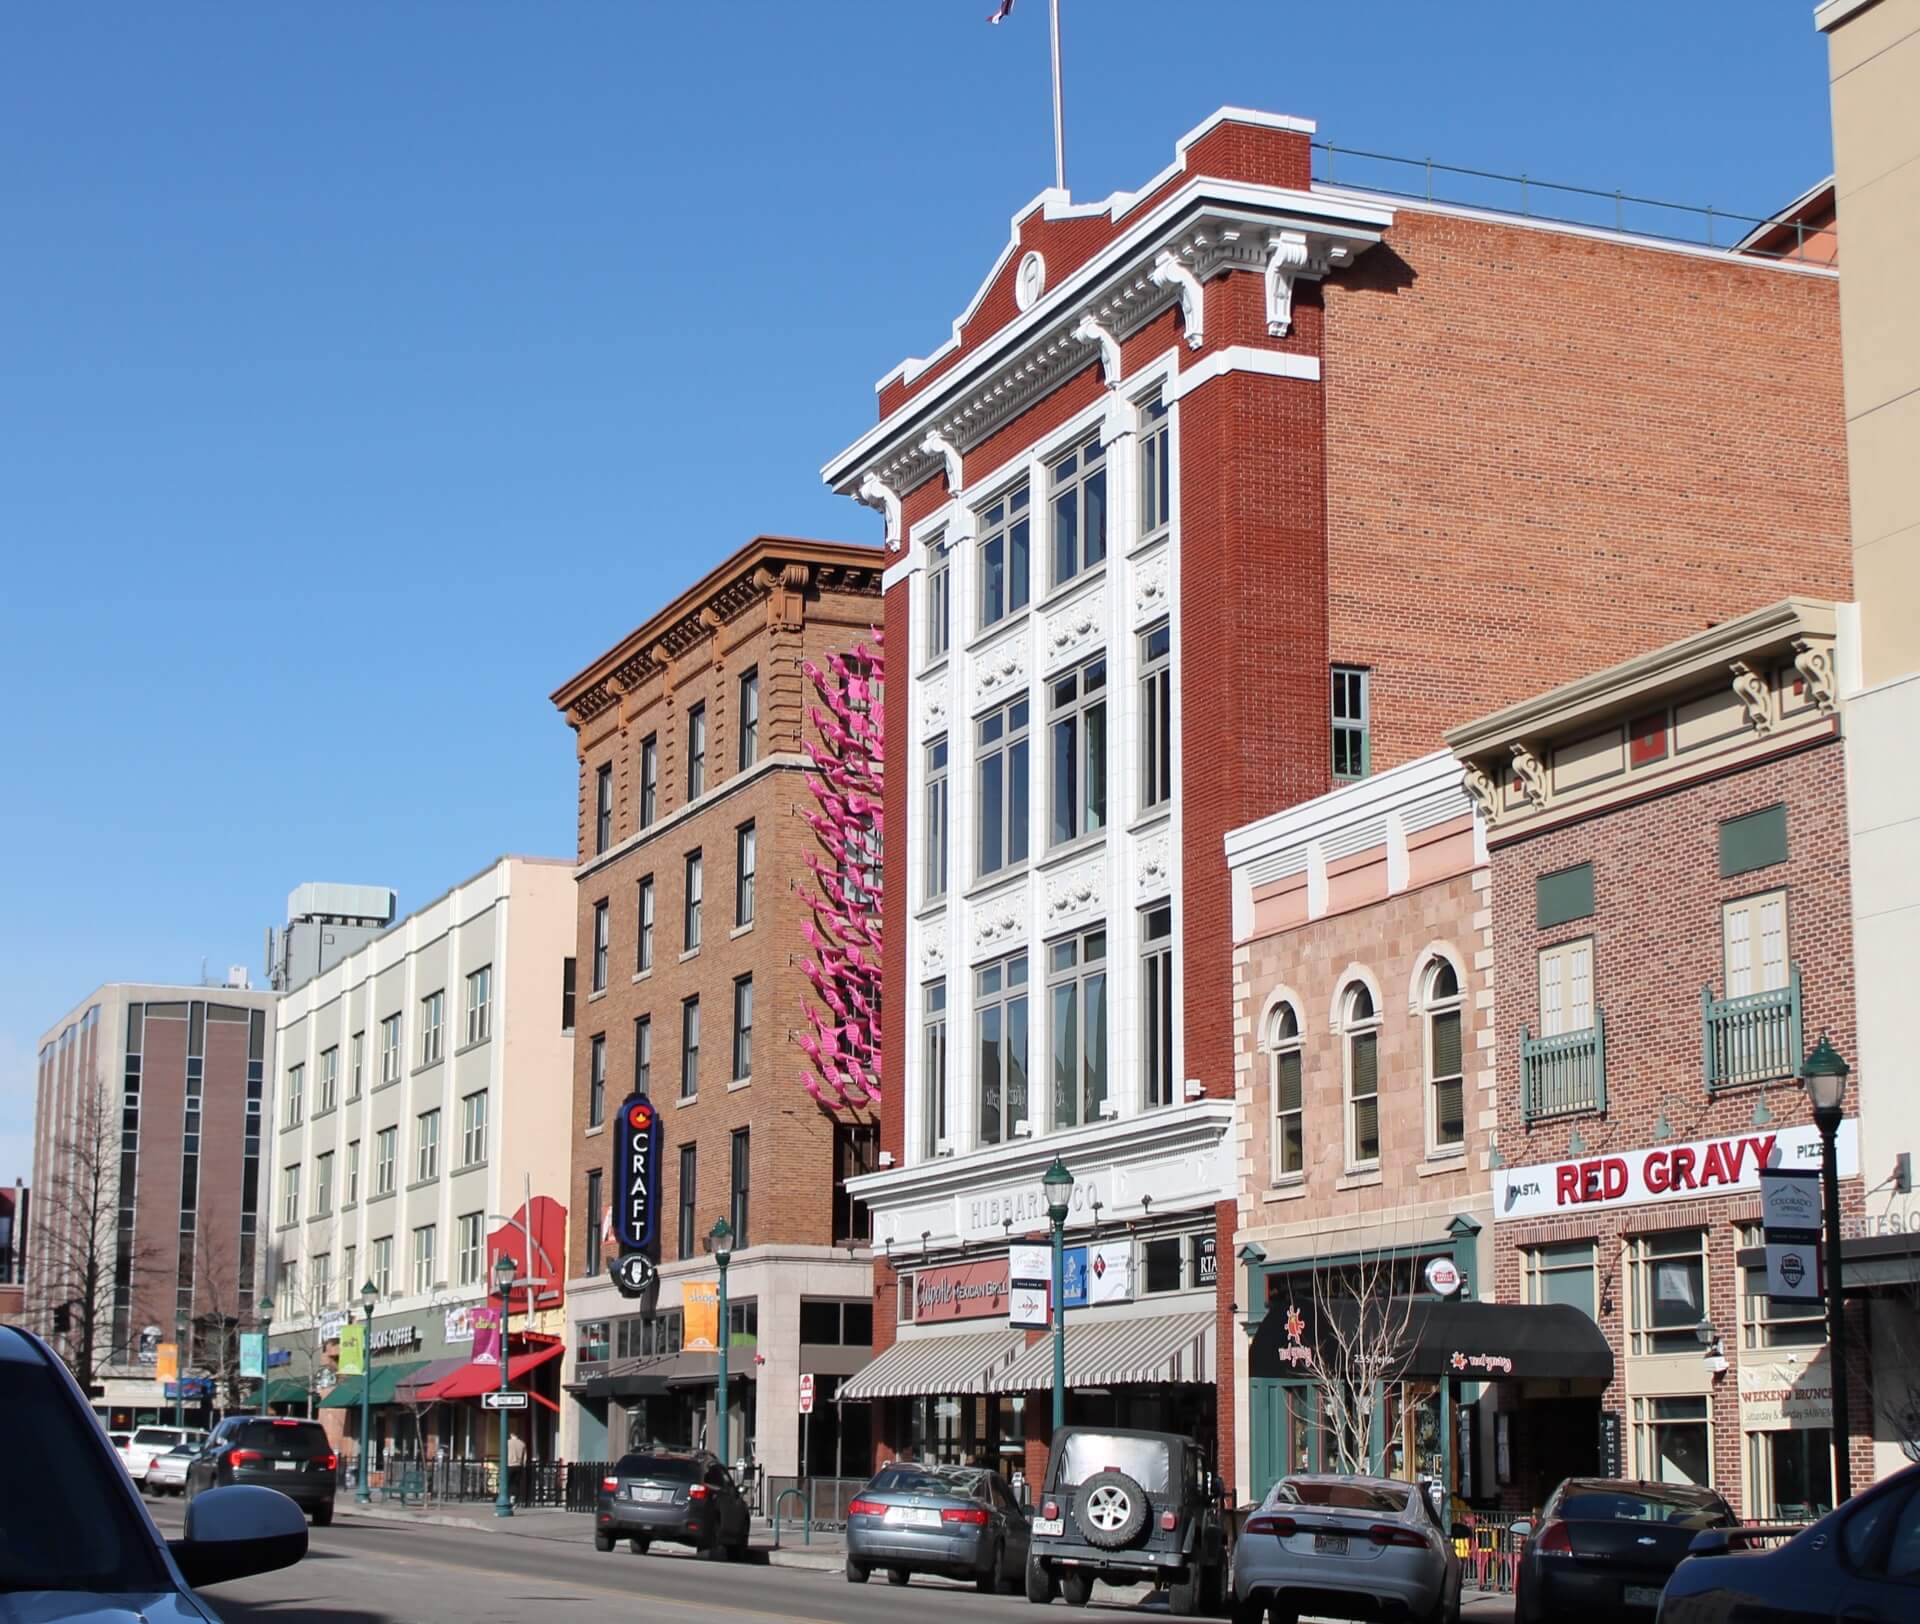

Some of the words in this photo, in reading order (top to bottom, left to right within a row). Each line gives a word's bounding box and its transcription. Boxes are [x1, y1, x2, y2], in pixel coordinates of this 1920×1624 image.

[1797, 1143, 1824, 1159] PIZZ
[1556, 1160, 1628, 1205] RED
[1643, 1135, 1776, 1193] GRAVY
[630, 1133, 648, 1241] CRAFT
[1510, 1183, 1541, 1197] PASTA
[917, 1275, 952, 1315] Chipotle
[389, 1325, 412, 1347] COFFEE
[1741, 1389, 1792, 1402] WEEKEND
